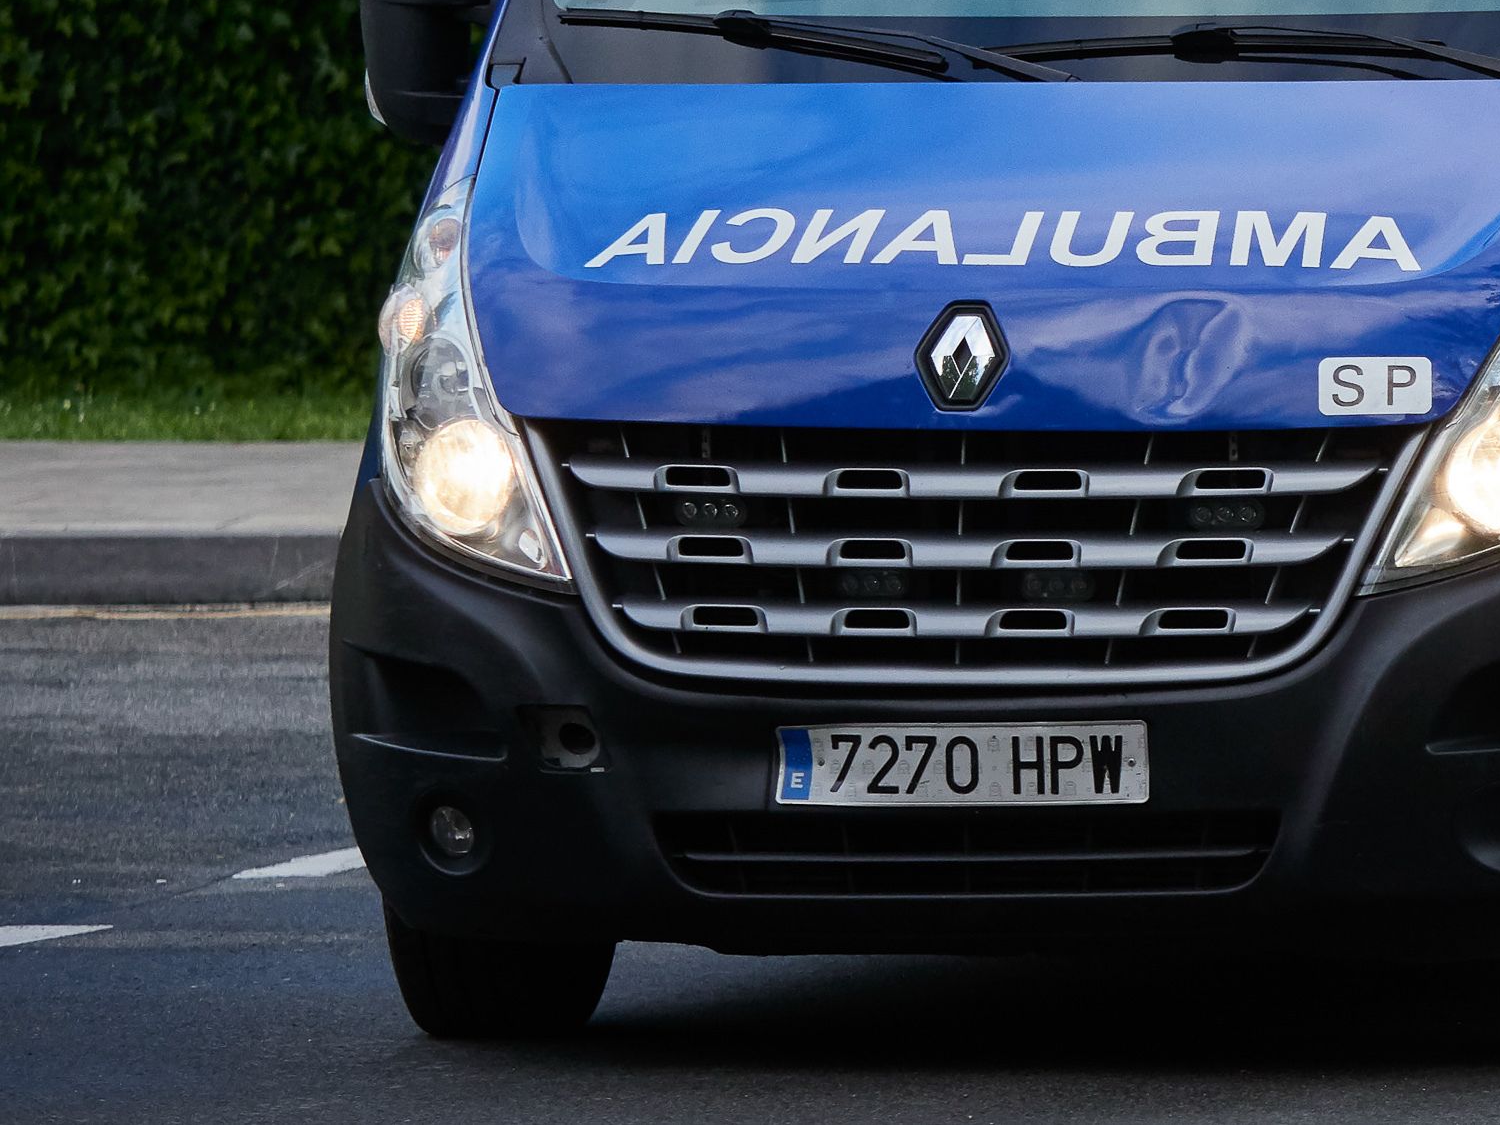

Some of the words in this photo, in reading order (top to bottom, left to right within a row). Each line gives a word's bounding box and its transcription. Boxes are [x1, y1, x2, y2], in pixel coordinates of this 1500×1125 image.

[791, 772, 804, 789] E
[829, 734, 979, 794] 7270
[1011, 735, 1123, 795] HPW
